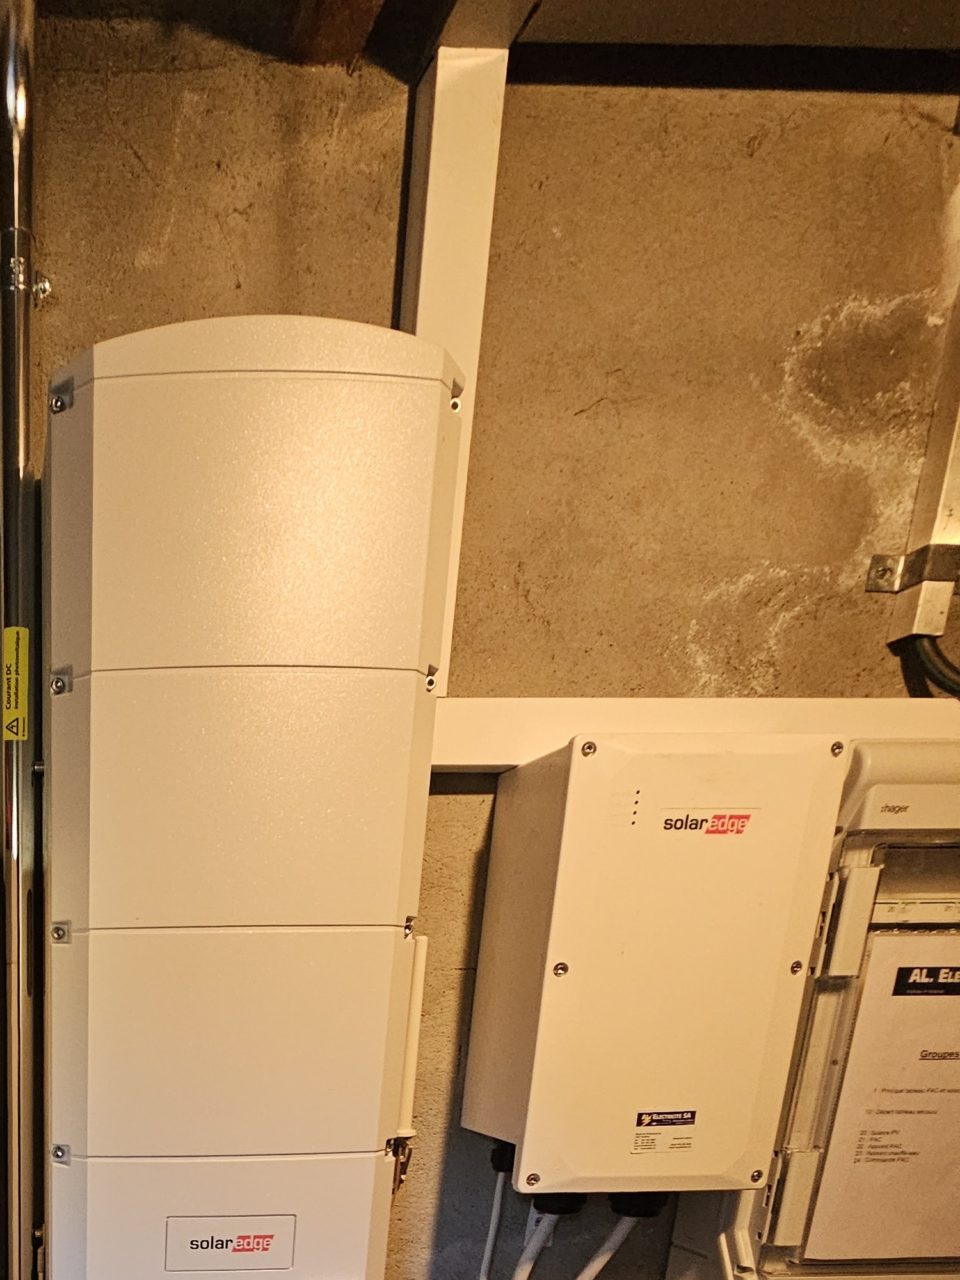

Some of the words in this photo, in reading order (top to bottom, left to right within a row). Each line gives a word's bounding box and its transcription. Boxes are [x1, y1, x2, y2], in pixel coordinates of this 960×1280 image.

[5, 663, 12, 676] DC
[663, 814, 750, 834] solaredge
[919, 1050, 960, 1060] Groupes
[189, 1235, 273, 1253] solaredge
